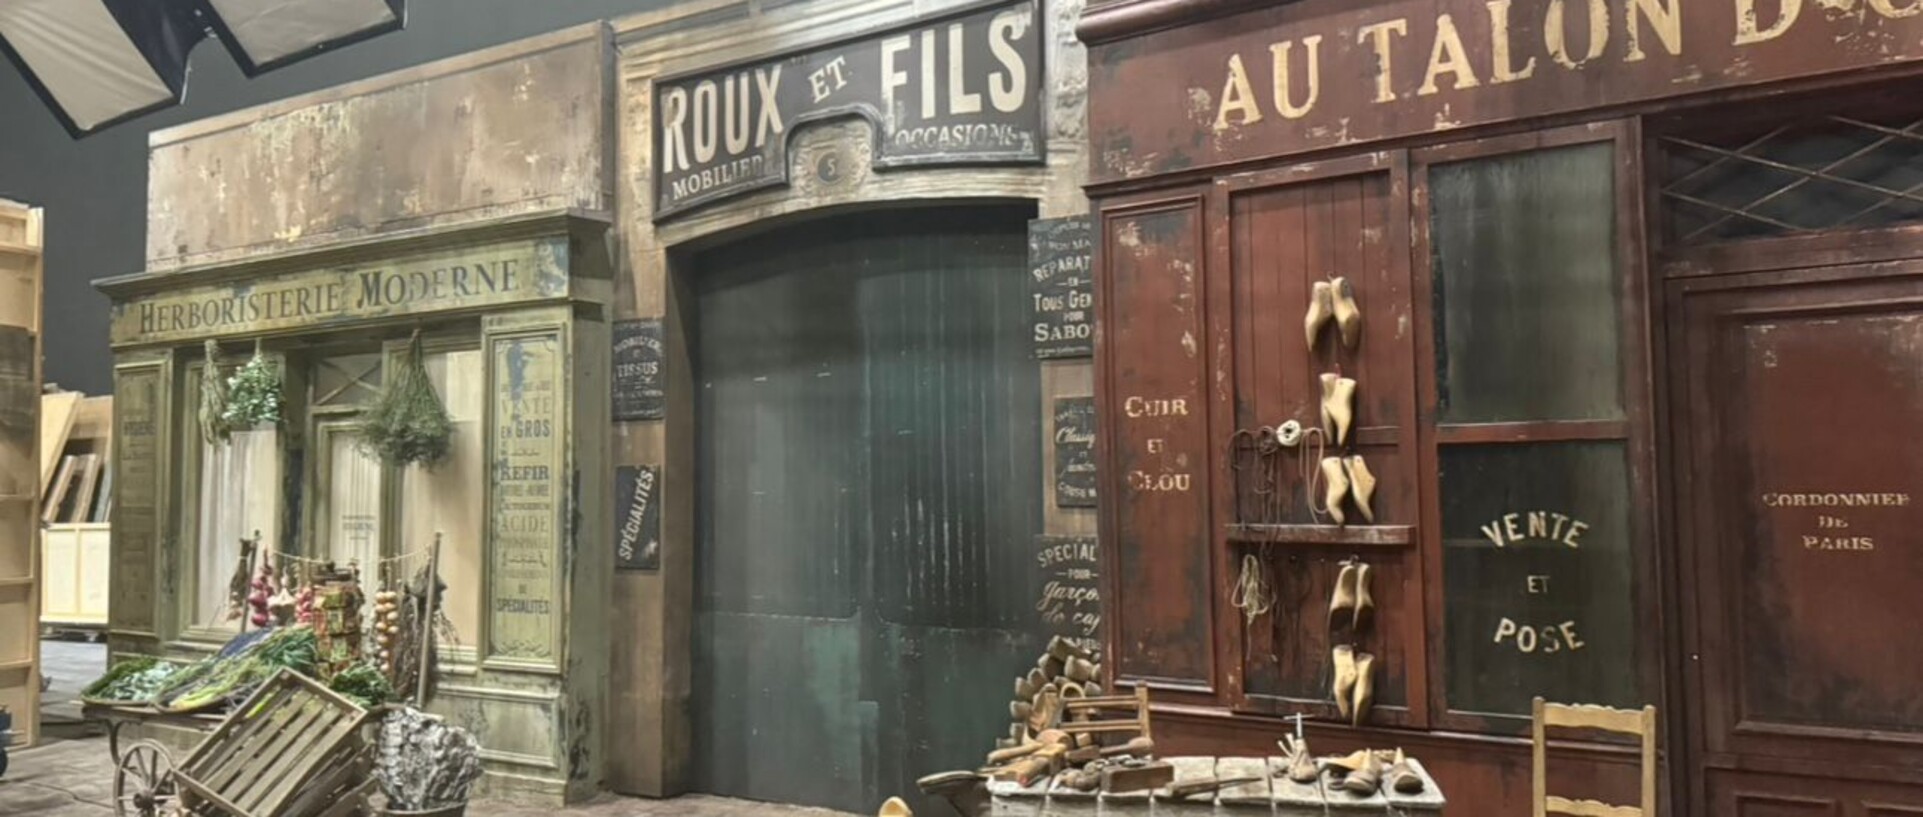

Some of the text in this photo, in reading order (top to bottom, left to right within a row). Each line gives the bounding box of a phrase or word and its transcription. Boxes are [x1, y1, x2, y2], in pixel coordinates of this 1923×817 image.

[1213, 34, 1322, 130] AU
[1356, 0, 1683, 104] TALON
[662, 10, 1032, 174] ROUX ET FILS
[139, 259, 519, 335] HERBORISTERIE MODERNE
[1034, 322, 1093, 342] SABO
[1124, 396, 1189, 418] CUIR
[515, 419, 550, 438] GROS
[618, 469, 654, 560] SPÉCIALITÉS
[1480, 511, 1589, 548] VENTE
[1803, 535, 1874, 550] PARIS
[1527, 574, 1551, 594] ET
[1494, 617, 1585, 653] POSE
